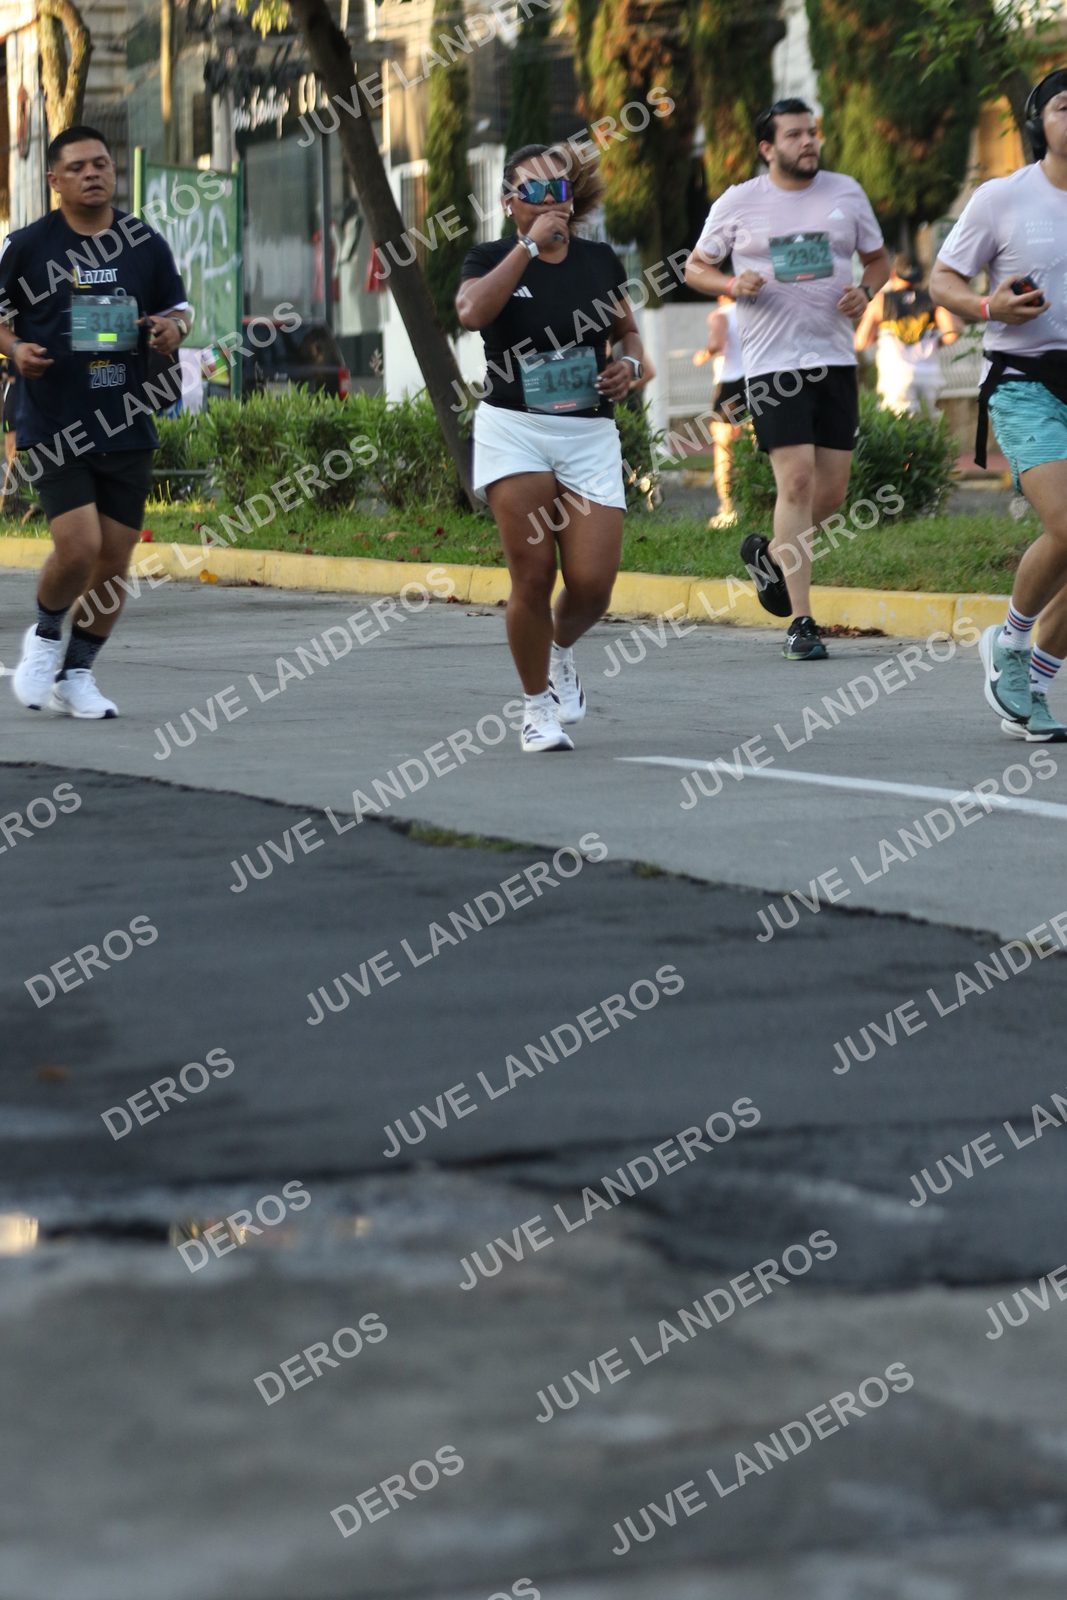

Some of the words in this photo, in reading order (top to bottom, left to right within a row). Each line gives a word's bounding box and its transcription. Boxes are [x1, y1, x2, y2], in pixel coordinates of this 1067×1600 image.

[787, 246, 832, 267] 2382
[91, 311, 136, 332] 3141
[89, 364, 127, 389] 2026
